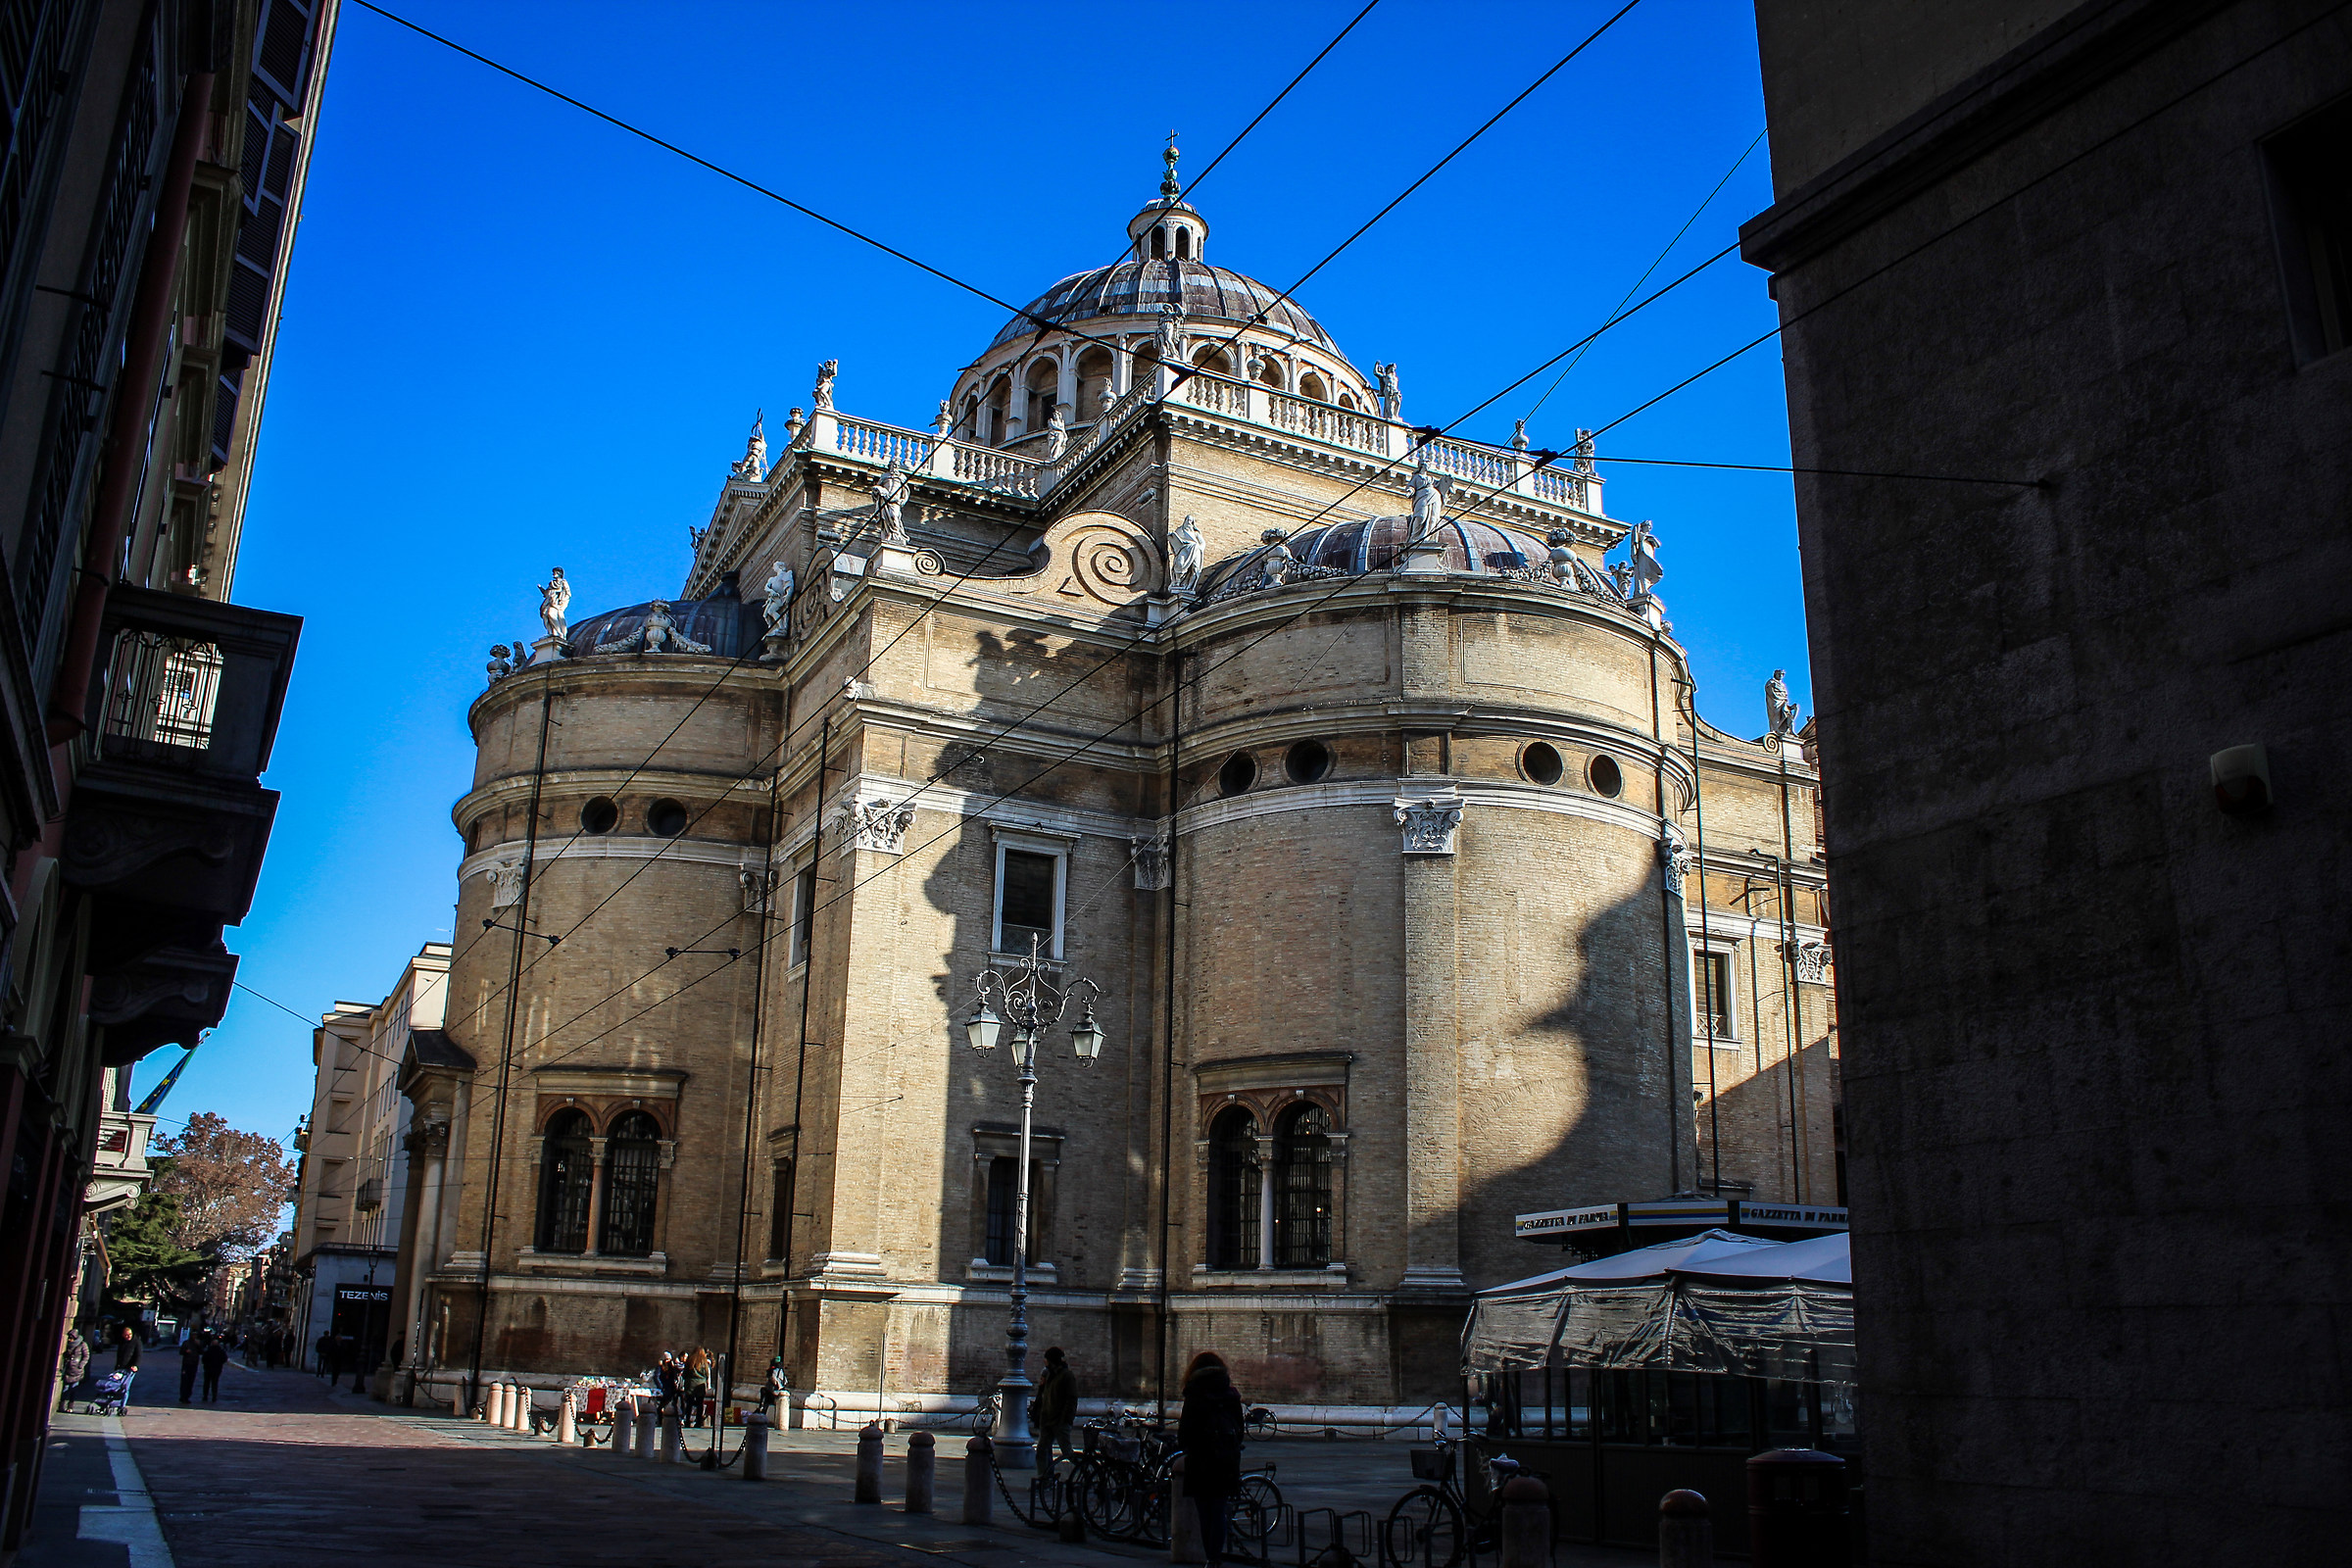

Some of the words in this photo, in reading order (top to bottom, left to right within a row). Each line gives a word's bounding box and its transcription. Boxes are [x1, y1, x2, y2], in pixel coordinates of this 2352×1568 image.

[1750, 1208, 1801, 1221] GAZZETTA
[1804, 1211, 1815, 1221] DI
[1523, 1216, 1564, 1229] GAZZETTA
[1568, 1215, 1577, 1225] DI
